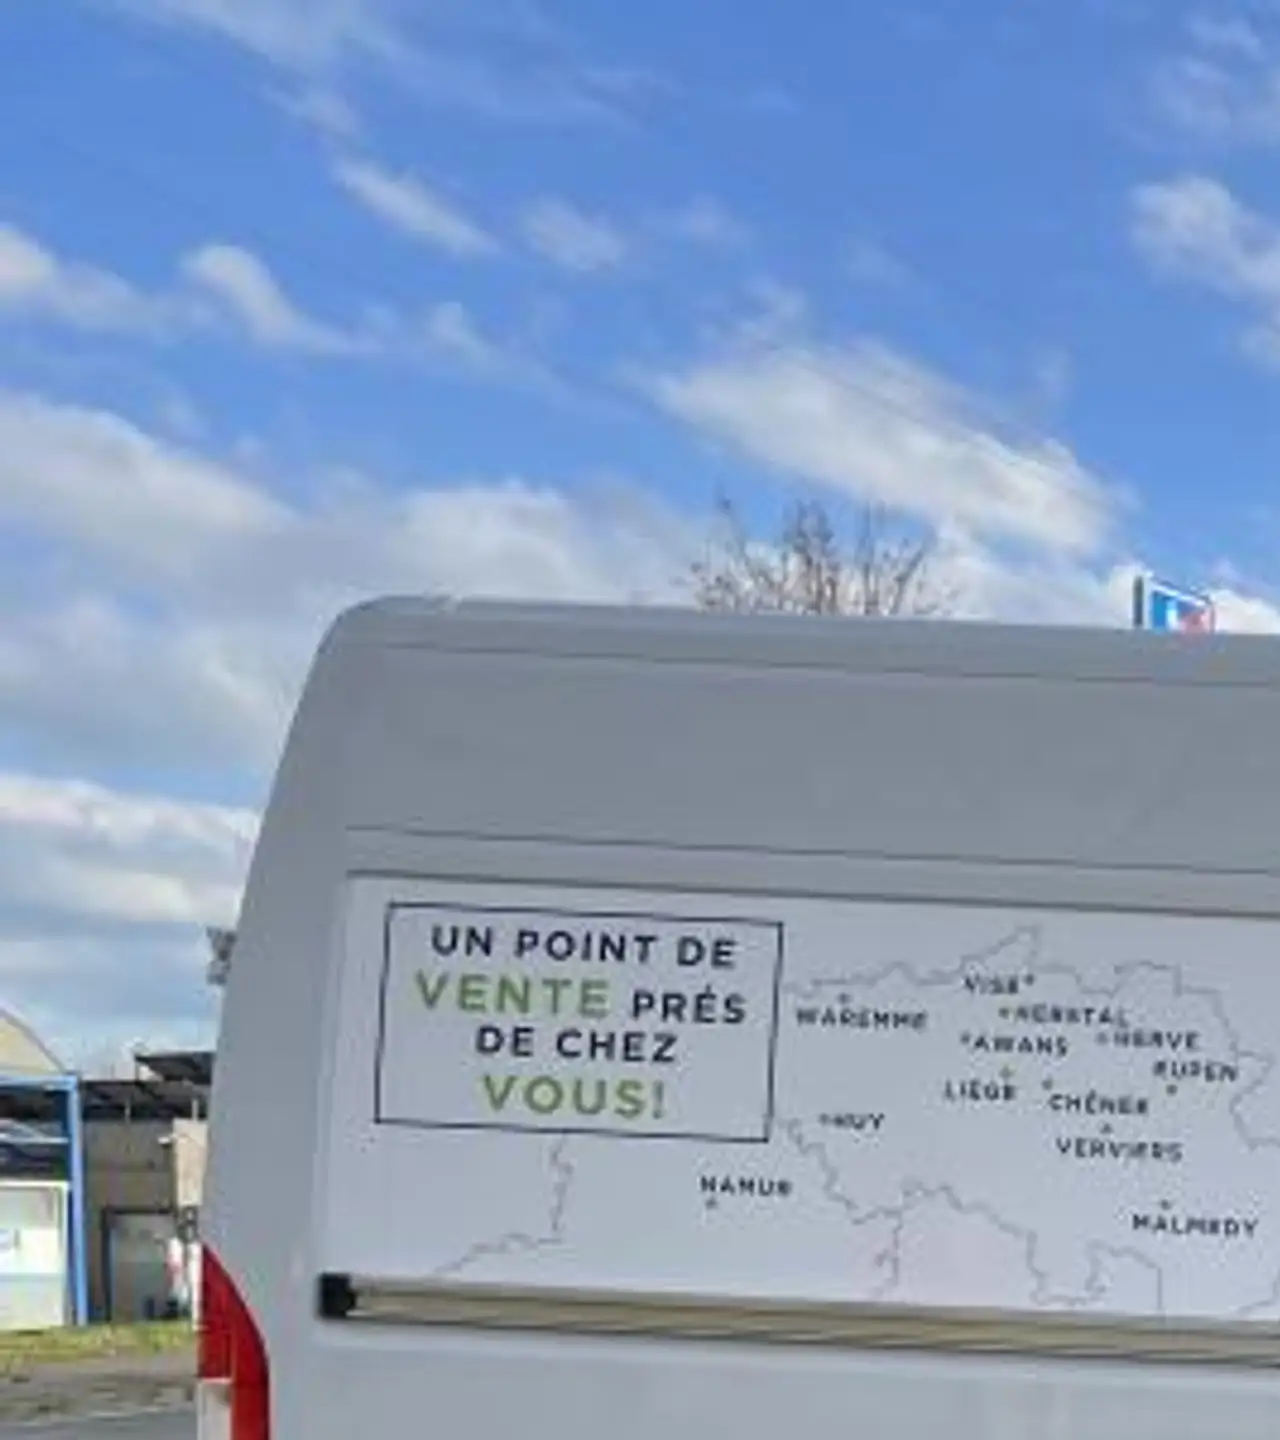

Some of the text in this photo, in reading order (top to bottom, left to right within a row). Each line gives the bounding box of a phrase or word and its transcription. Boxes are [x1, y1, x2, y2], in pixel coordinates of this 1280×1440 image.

[431, 925, 737, 968] UN POINT DE
[415, 968, 748, 1025] VENTE PRÉS
[797, 1006, 928, 1031] WAREMME
[1017, 1004, 1129, 1029] HERSTAL
[476, 1026, 679, 1063] DE CHEZ
[974, 1034, 1067, 1056] AWANS
[1113, 1029, 1200, 1050] HERVE
[1153, 1060, 1238, 1083] EUPEN
[484, 1074, 667, 1121] VOUS!
[832, 1112, 885, 1131] HUY
[1056, 1137, 1184, 1163] VERVIERS
[701, 1175, 793, 1198] NAMUR
[1132, 1213, 1259, 1239] MALMEDY
